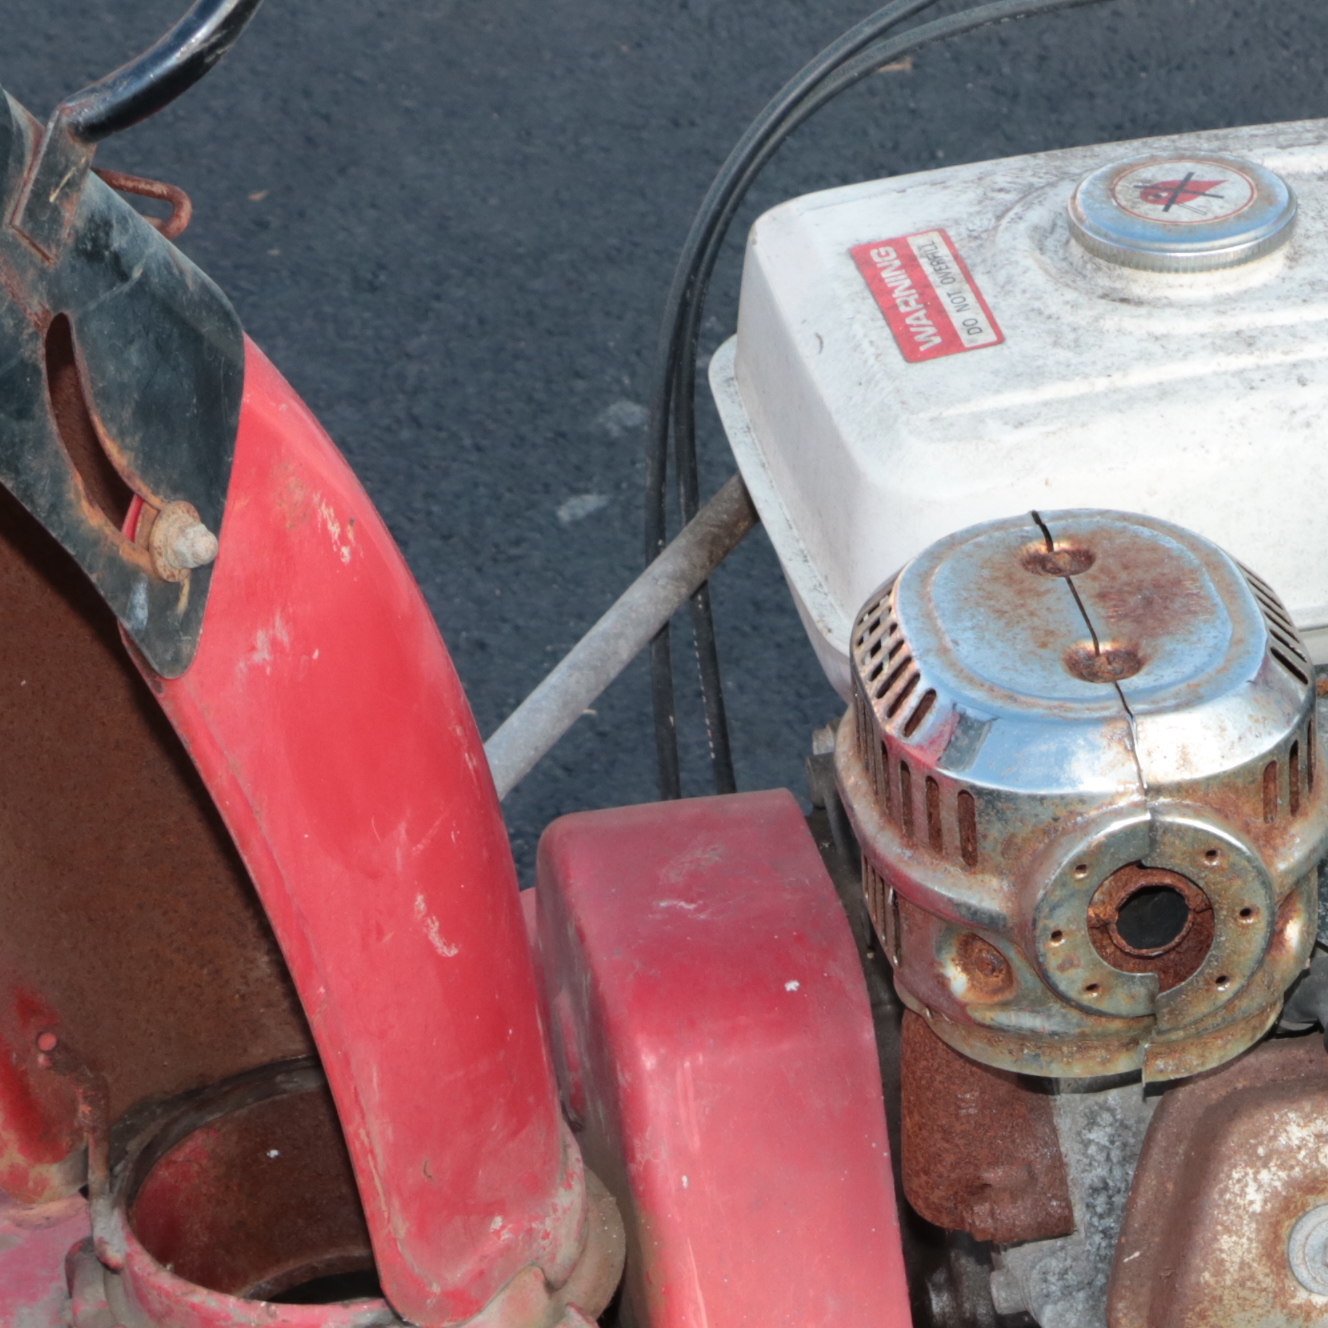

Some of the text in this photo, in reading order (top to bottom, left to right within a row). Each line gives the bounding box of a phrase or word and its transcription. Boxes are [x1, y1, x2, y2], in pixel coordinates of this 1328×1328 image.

[869, 246, 943, 352] WARNING
[917, 240, 983, 336] DO NOT OVERFILL
